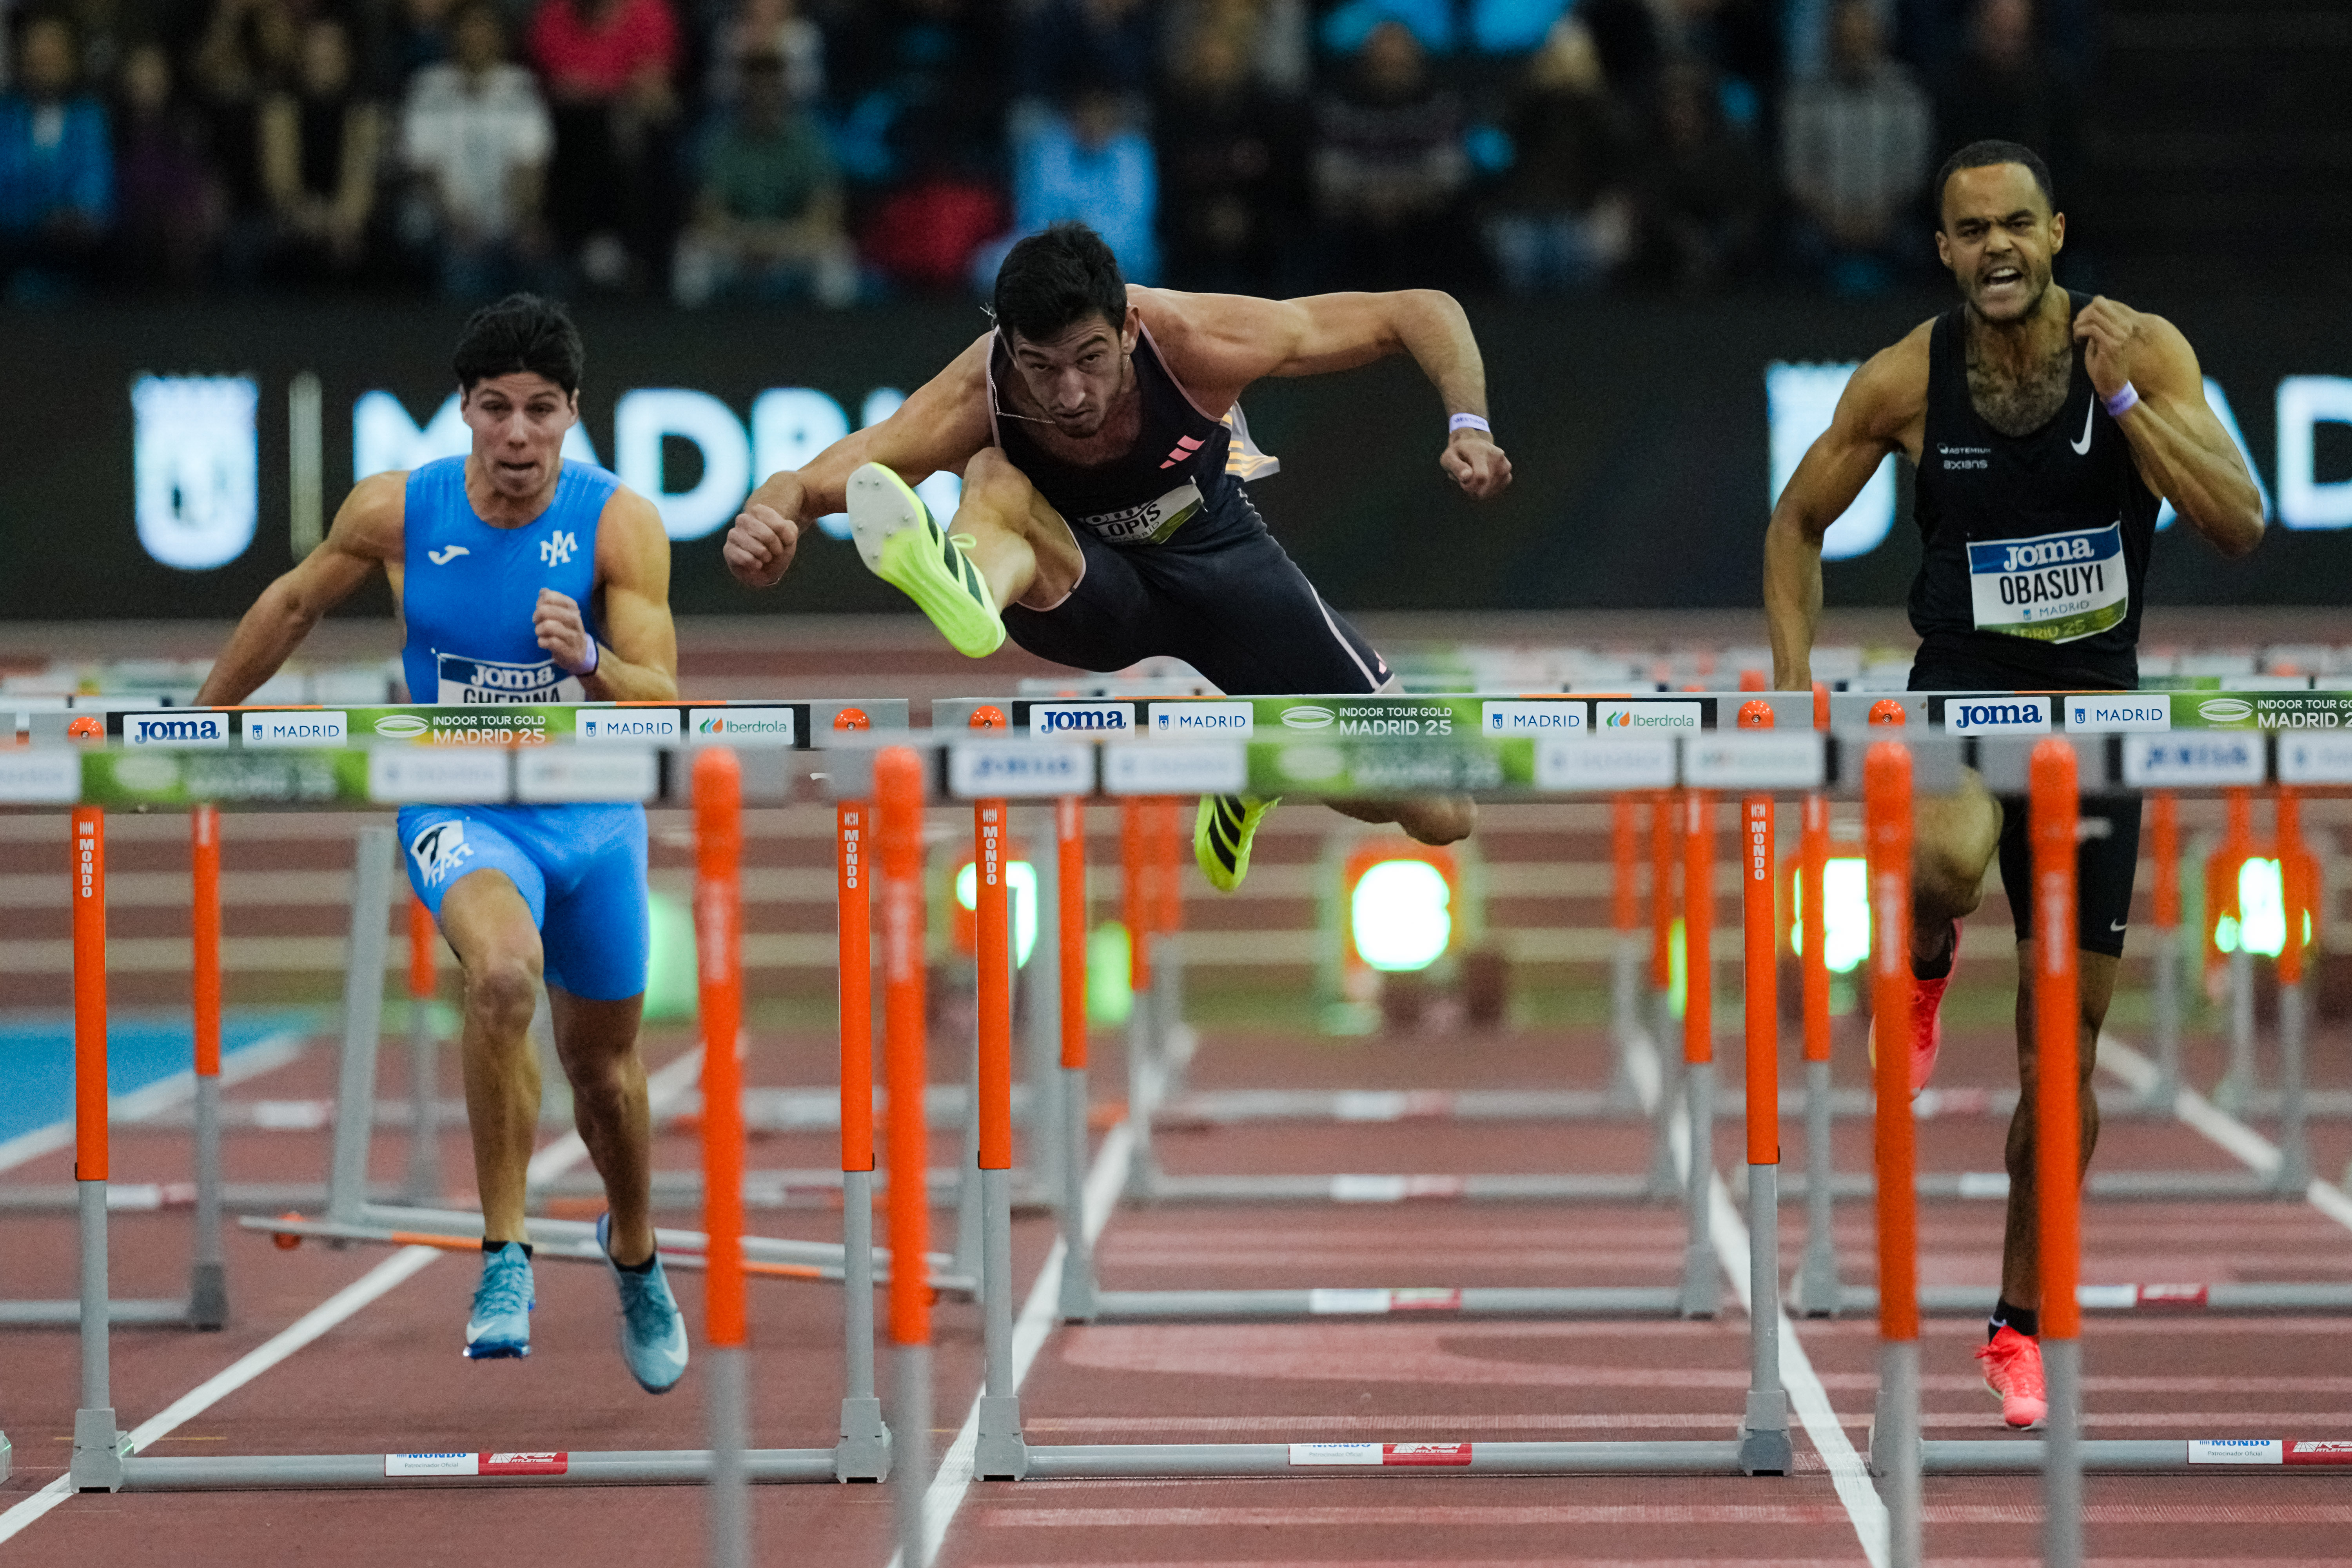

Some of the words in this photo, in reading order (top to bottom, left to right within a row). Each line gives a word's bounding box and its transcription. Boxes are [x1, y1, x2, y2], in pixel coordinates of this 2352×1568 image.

[2000, 564, 2104, 605] OBASUYI
[2040, 600, 2090, 617] MADRID
[2257, 699, 2302, 709] INDOOR
[2306, 699, 2337, 709] TOUR
[1339, 708, 1383, 717] INDOOR
[1387, 708, 1417, 717] TOUR
[1420, 708, 1452, 717] GOLD
[2096, 708, 2163, 721] MADRID
[433, 716, 477, 725] INDOOR
[481, 716, 511, 725] TOUR
[514, 716, 546, 725] GOLD
[726, 720, 787, 733] Iberdrola
[1180, 716, 1246, 728] MADRID
[1514, 715, 1580, 727] MADRID
[1634, 714, 1694, 727] Iberdrola
[2258, 712, 2339, 728] MADRID
[274, 725, 339, 737] MADRID
[607, 722, 673, 734] MADRID
[1339, 720, 1419, 735] MADRID
[1425, 720, 1452, 735] 25
[434, 728, 513, 744] MADRID
[518, 728, 546, 744] 25
[983, 826, 998, 885] MONDO
[1751, 821, 1766, 880] MONDO
[844, 829, 859, 889] MONDO
[80, 838, 94, 898] MONDO
